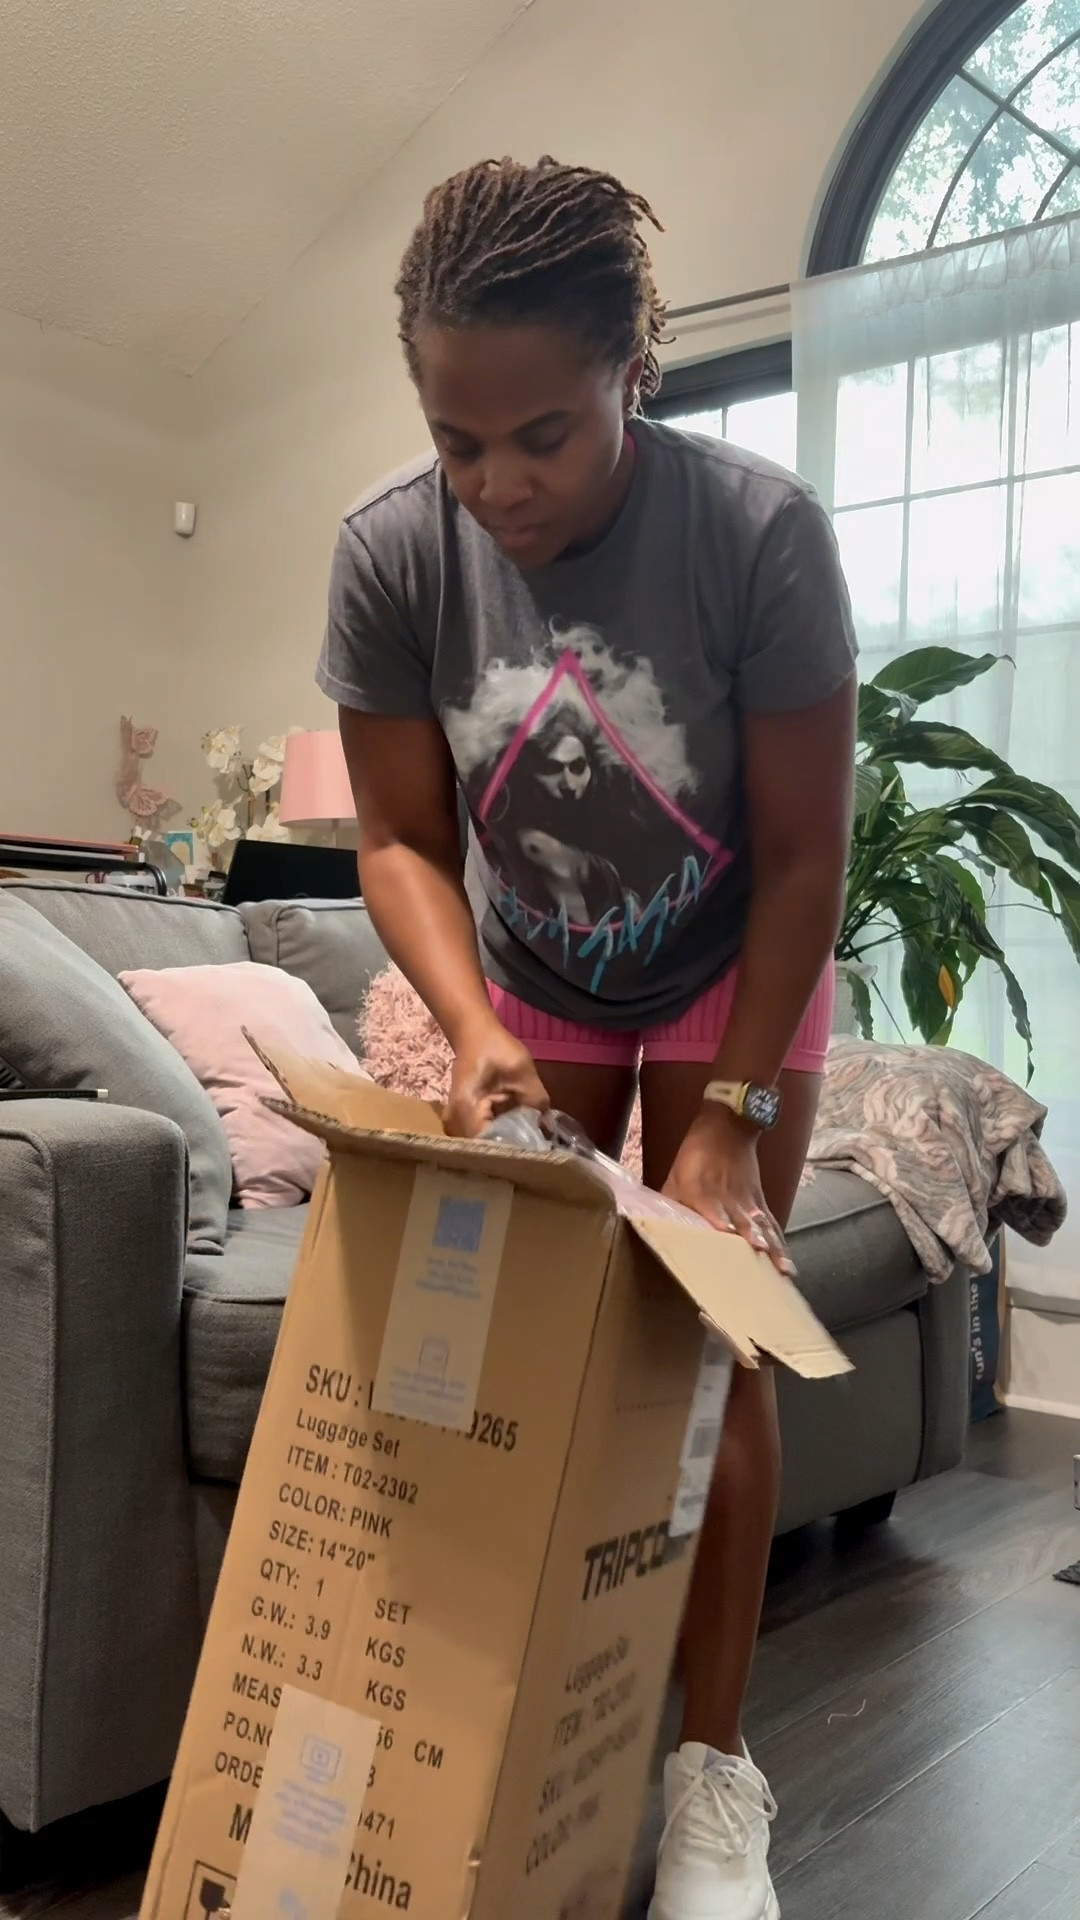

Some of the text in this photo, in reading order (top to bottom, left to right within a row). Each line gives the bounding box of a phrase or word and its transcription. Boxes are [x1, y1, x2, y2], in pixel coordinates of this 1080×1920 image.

[295, 1408, 400, 1458] Luggage Set
[278, 1482, 394, 1539] COLOR: PINK
[343, 1461, 419, 1505] T02-2302
[269, 1520, 314, 1553] SIZE:
[260, 1558, 412, 1626] QTY: 1 SET
[304, 1615, 332, 1641] 3.9
[365, 1636, 406, 1669] KGS
[296, 1654, 323, 1682] 3.3
[365, 1679, 407, 1712] KGS
[223, 1711, 273, 1748] PO.N
[232, 1672, 282, 1709] MEAS
[414, 1739, 444, 1769] CM
[214, 1751, 264, 1789] ORDE
[357, 1810, 396, 1841] 471
[344, 1851, 412, 1912] hina
